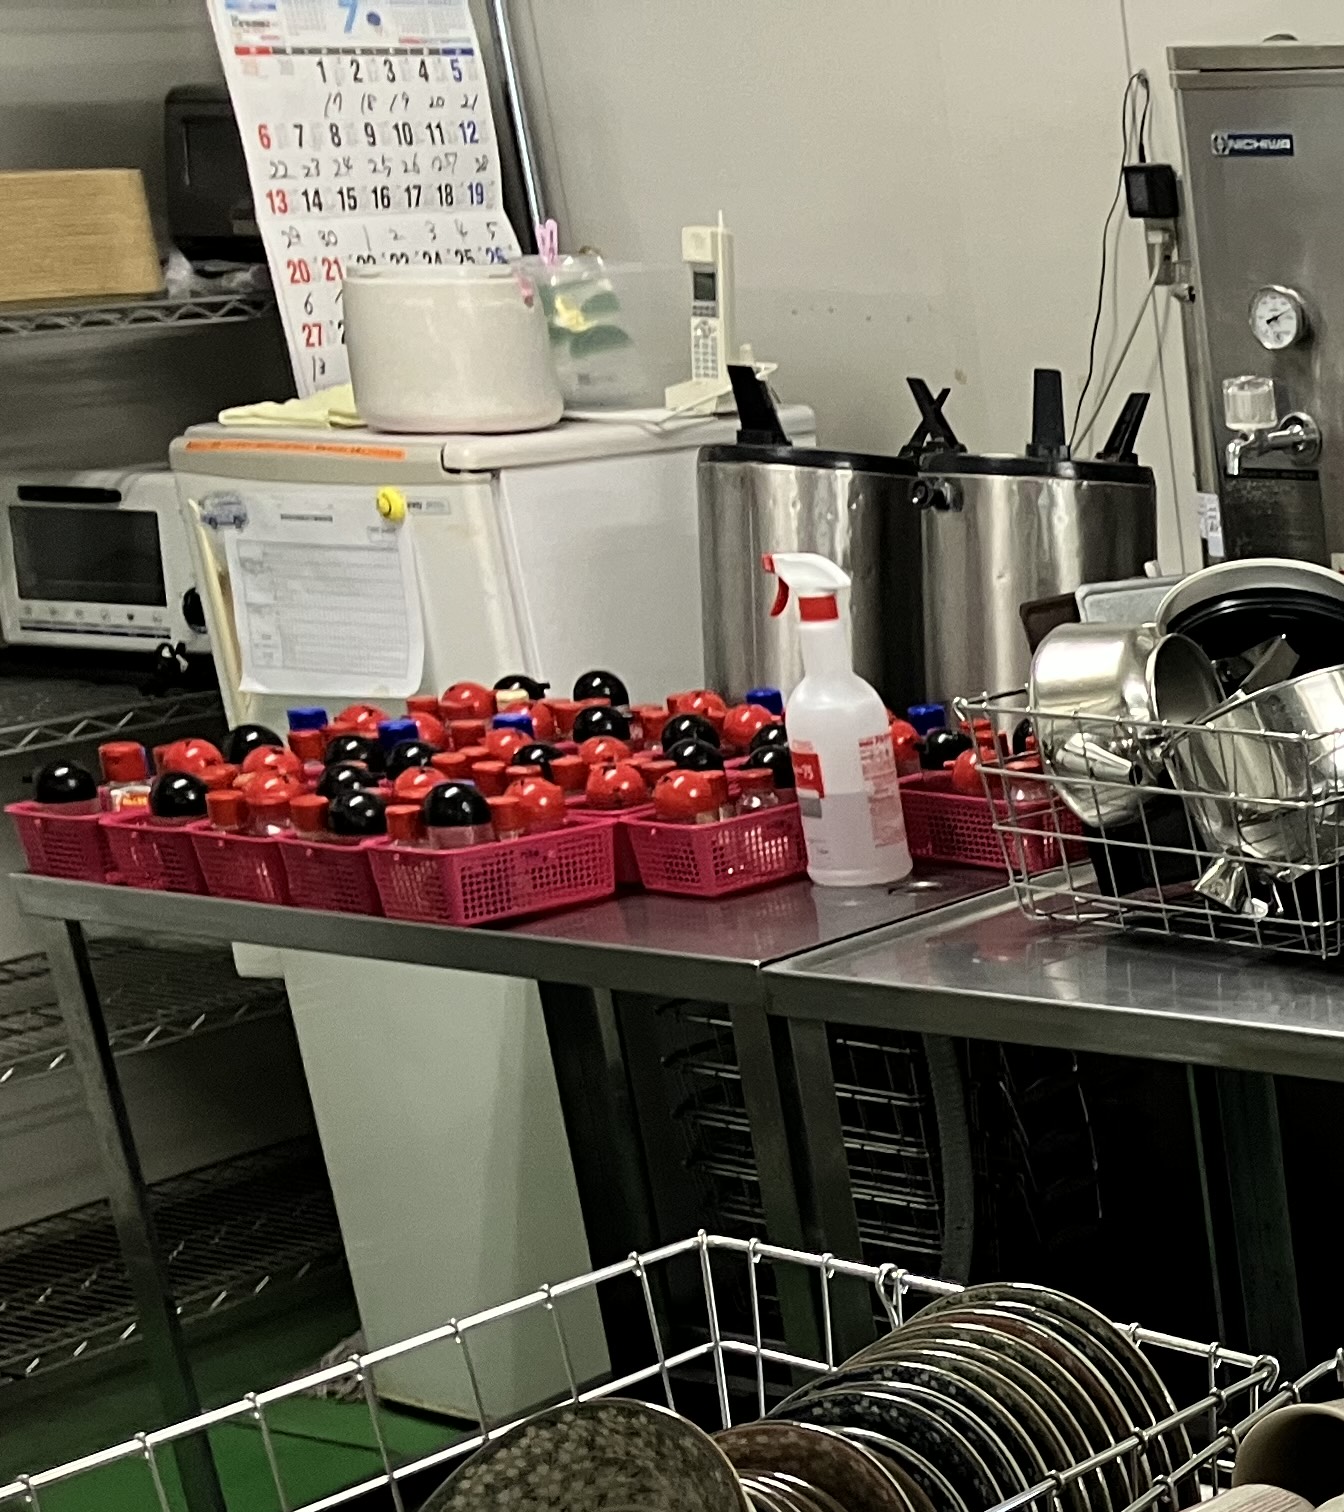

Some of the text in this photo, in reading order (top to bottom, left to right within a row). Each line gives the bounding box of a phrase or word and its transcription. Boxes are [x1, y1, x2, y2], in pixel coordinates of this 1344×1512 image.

[316, 58, 463, 84] 1 2 3 4 5
[258, 120, 480, 150] 6 7 8 9 10 11 12
[266, 181, 485, 215] 13 14 15 16 17 18 19
[286, 258, 312, 285] 20
[320, 256, 345, 283] 21
[302, 322, 323, 348] 27
